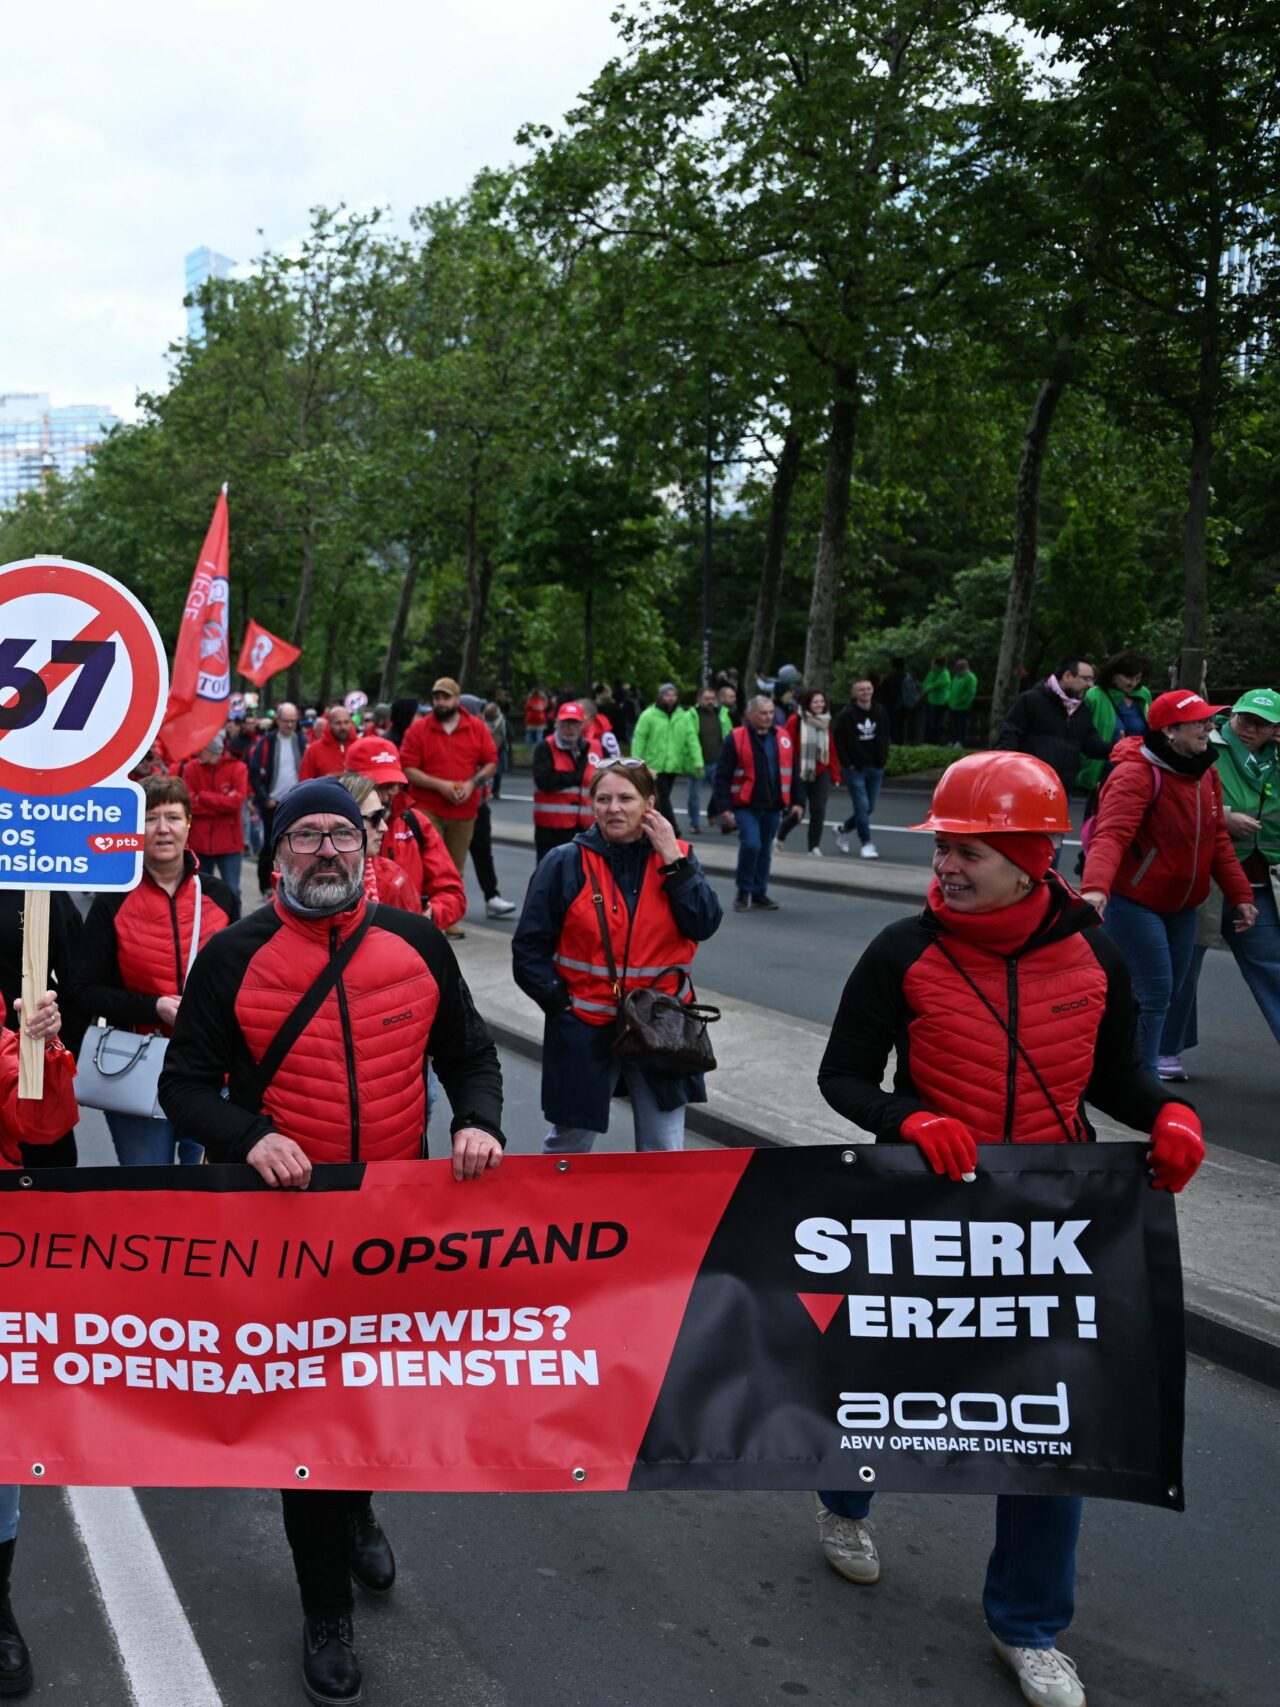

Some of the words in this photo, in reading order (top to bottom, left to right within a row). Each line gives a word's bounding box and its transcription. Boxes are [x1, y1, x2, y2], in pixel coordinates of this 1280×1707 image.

[20, 799, 122, 823] touche
[116, 837, 139, 848] ptb
[383, 1009, 412, 1025] acod
[278, 1239, 334, 1279] IN
[352, 1220, 629, 1276] OPSTAND
[794, 1217, 1093, 1277] STERK
[74, 1313, 220, 1354] DOOR
[234, 1305, 571, 1356] ONDERWIJS?
[53, 1352, 327, 1395] OPENBARE
[341, 1349, 599, 1388] DIENSTEN
[836, 1381, 1071, 1435] acod
[840, 1435, 885, 1451] ABVV
[889, 1436, 980, 1452] OPENBARE
[984, 1437, 1072, 1456] DIENSTEN
